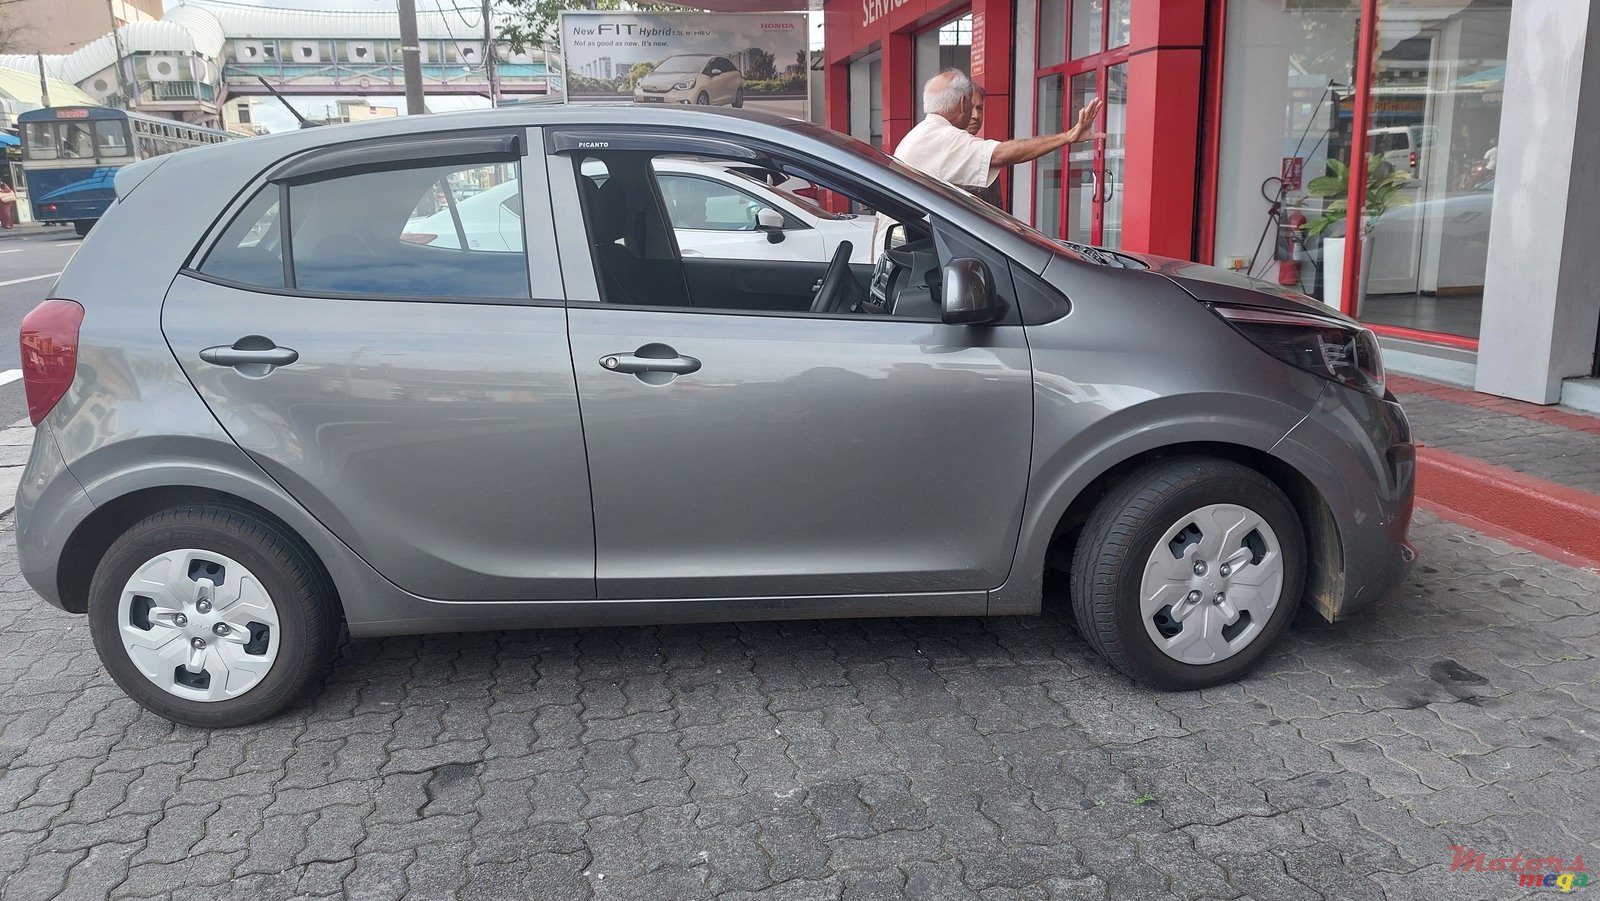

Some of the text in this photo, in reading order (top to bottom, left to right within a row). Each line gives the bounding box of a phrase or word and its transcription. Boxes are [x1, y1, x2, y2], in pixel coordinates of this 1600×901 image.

[862, 0, 909, 28] SERV
[573, 27, 595, 35] New
[598, 23, 638, 35] FIT
[639, 27, 672, 37] Hybrid
